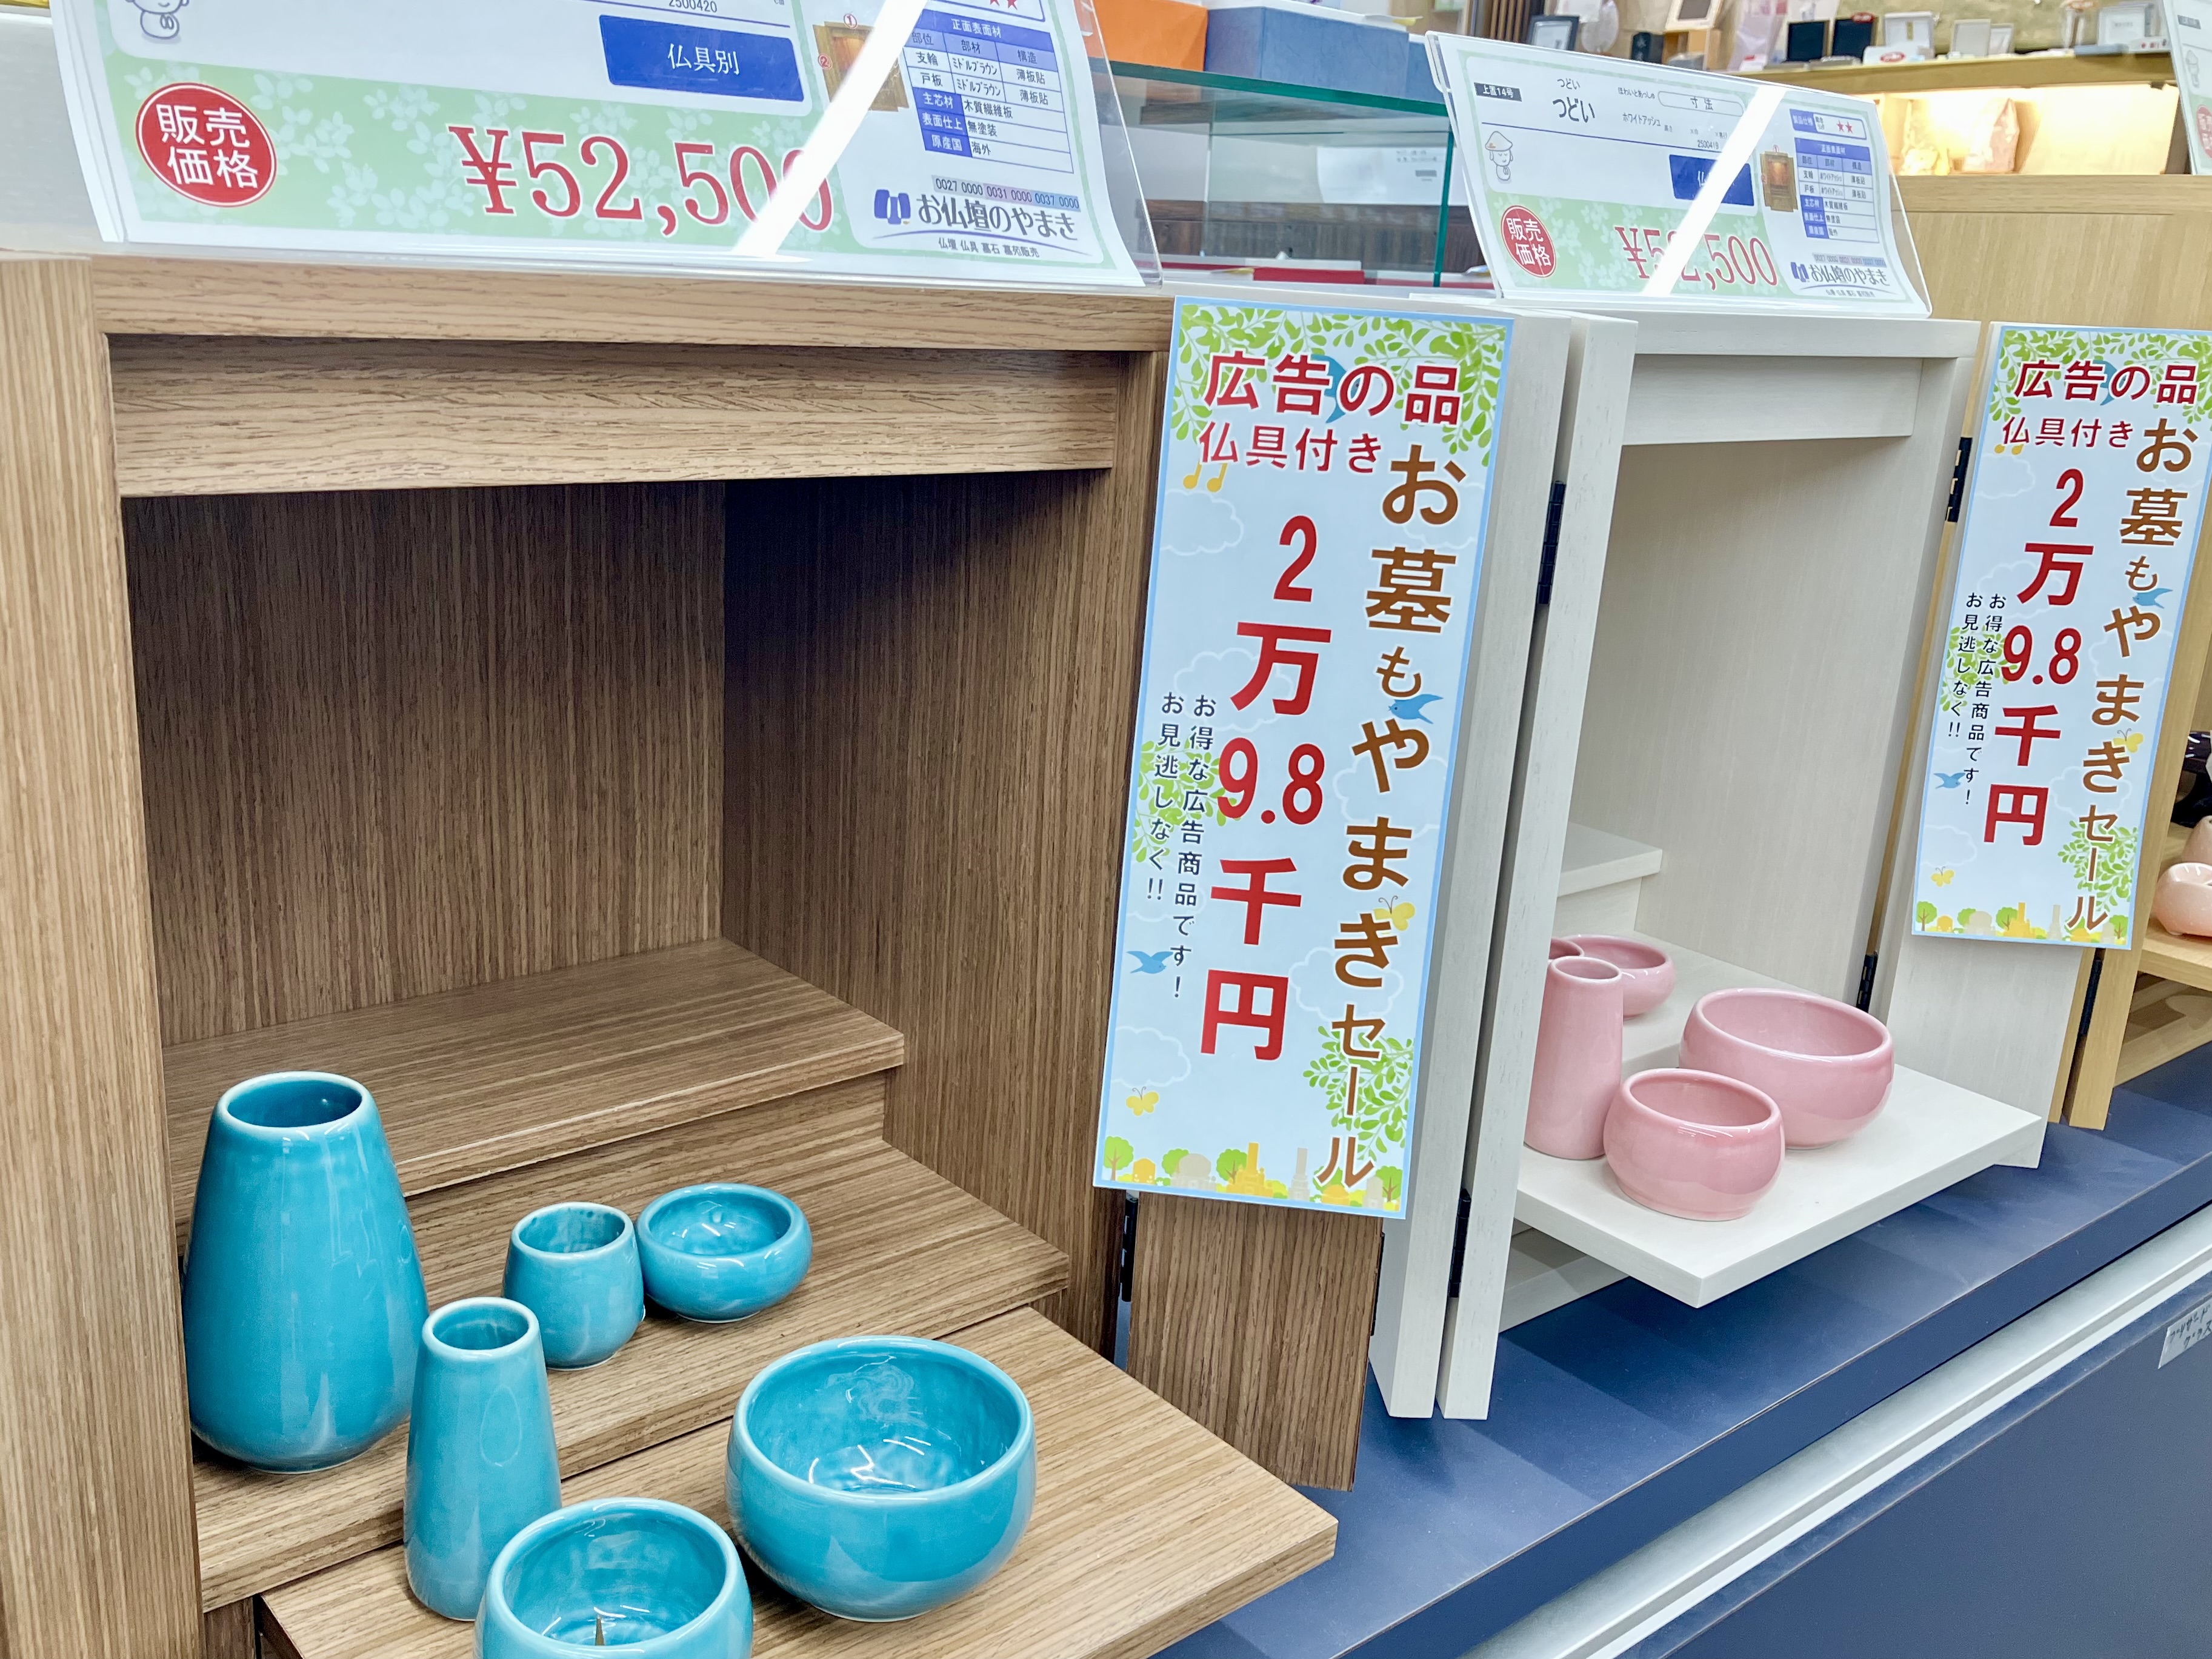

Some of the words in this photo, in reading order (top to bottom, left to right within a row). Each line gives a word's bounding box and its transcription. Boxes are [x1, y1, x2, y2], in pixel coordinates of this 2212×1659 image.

[668, 0, 717, 13] 2500420
[911, 32, 934, 45] 部位
[951, 18, 1002, 38] 正面表面材
[961, 39, 981, 54] 部材
[1018, 49, 1038, 64] 構造
[667, 43, 739, 75] 仏具別
[916, 52, 938, 66] 支輪
[920, 72, 943, 87] 戸板
[1016, 68, 1045, 85] 薄板貼
[1557, 78, 1581, 90] つどい
[922, 92, 953, 109] 主芯材
[1019, 90, 1048, 105] 薄板貼
[964, 99, 1013, 119] 木質繊維板
[1552, 96, 1595, 123] つどい
[155, 104, 250, 148] 販売
[922, 113, 963, 131] 表面仕上
[967, 120, 998, 137] 無塗装
[931, 135, 962, 151] 原産国
[971, 141, 991, 156] 海外
[1697, 139, 1719, 150] 2500419
[167, 147, 259, 189] 価格
[935, 178, 958, 192] 0027
[961, 182, 983, 196] 0000
[987, 185, 1007, 199] 0031
[1011, 190, 1033, 203] 0000
[1035, 193, 1054, 206] 0037
[1059, 196, 1079, 210] 0000
[916, 194, 1078, 241] お仏壇のやまき
[1507, 218, 1544, 243] 販売
[1515, 242, 1552, 268] 価格
[1808, 264, 1890, 287] お仏壇のやまき
[1204, 350, 1461, 425] 広告の品
[2014, 359, 2197, 405] 広告の品
[2002, 416, 2134, 448] 仏具付き
[1198, 421, 1382, 473] 仏具付き
[1984, 468, 2094, 846] 2万9.8千円
[2067, 417, 2199, 931] お墓もやまきセール
[1200, 514, 1332, 1062] 2万9.8千円
[1318, 444, 1467, 1190] お墓もやまきセール
